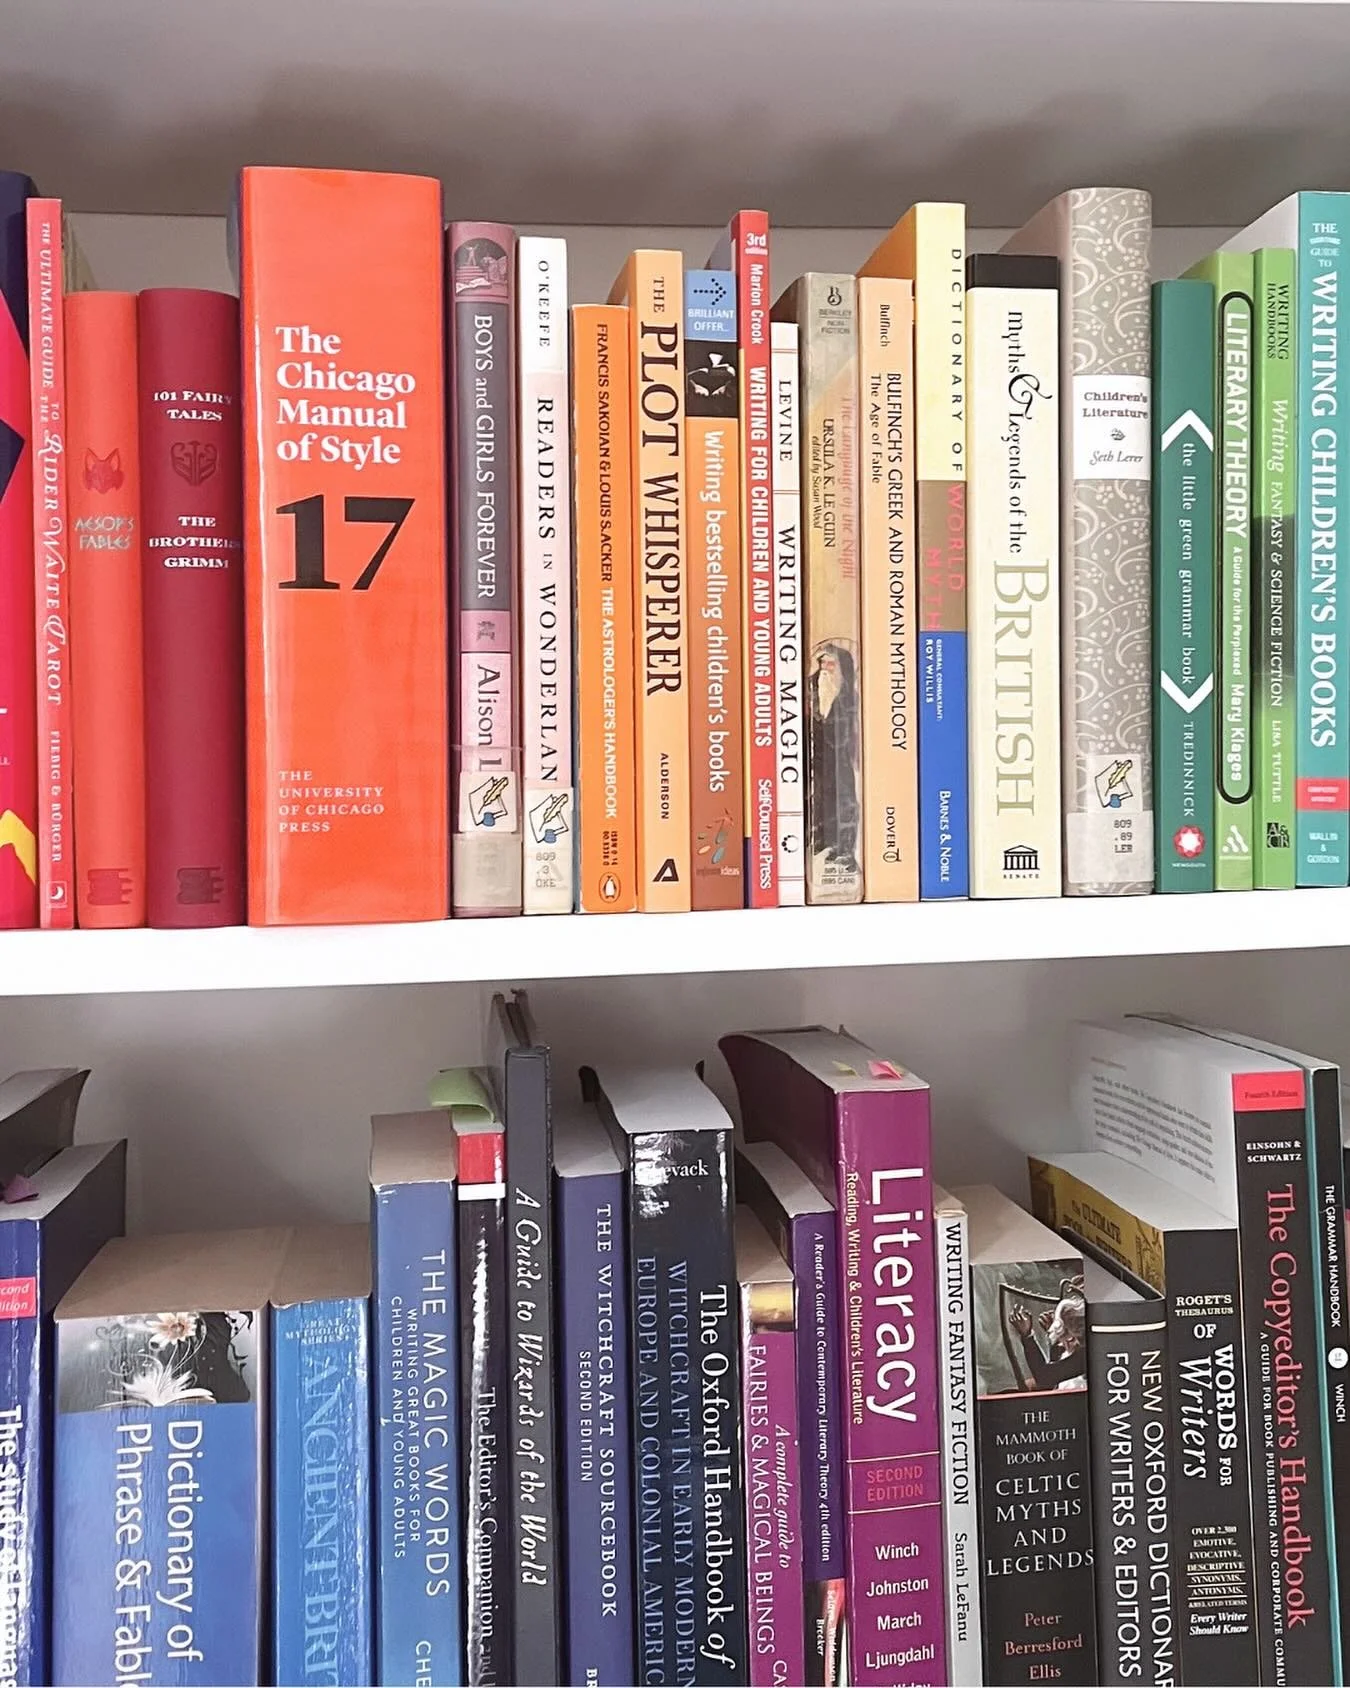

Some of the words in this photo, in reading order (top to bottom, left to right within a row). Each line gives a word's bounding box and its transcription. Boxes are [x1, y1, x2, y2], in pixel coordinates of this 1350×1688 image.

[747, 233, 766, 246] 3rd
[1312, 223, 1338, 233] THE
[1310, 248, 1340, 256] GUIDE
[537, 260, 550, 347] O'KEEFE
[653, 276, 665, 313] THE
[750, 264, 764, 307] Marion
[688, 308, 734, 319] BRILLIANT
[750, 309, 764, 345] Crook
[880, 304, 890, 347] Bulfinch
[951, 248, 963, 421] DICTIONARY
[1267, 283, 1276, 359] HANDBOOKS
[1277, 284, 1289, 360] WRITING
[276, 326, 341, 354] The
[474, 315, 493, 371] BOYS
[1312, 271, 1338, 417] WRITING
[154, 392, 178, 403] 101
[183, 391, 231, 404] FAIRY
[276, 362, 416, 400] Chicago
[474, 377, 492, 409] and
[641, 322, 679, 457] PLOT
[750, 366, 767, 440] WRITING
[1084, 392, 1148, 402] Children's
[166, 408, 223, 421] TALES
[276, 398, 407, 429] Manual
[779, 380, 792, 462] LEVINE
[887, 373, 903, 463] BULFINCH'S
[1082, 408, 1148, 418] Literature
[276, 432, 318, 461] of
[320, 436, 400, 471] Style
[474, 415, 495, 483] GIRLS
[700, 430, 725, 503] Writing
[751, 446, 767, 481] FOR
[951, 442, 963, 471] OF
[1089, 451, 1113, 465] Seth
[1117, 451, 1143, 463] Lerer
[1183, 443, 1195, 466] the
[887, 468, 904, 520] GREEK
[1182, 475, 1195, 510] little
[79, 535, 131, 550] FABLES
[178, 516, 216, 527] THE
[276, 494, 416, 590] 17
[751, 487, 769, 573] CHILDREN
[947, 484, 965, 591] WORLD
[1179, 519, 1192, 560] green
[1311, 428, 1337, 623] CHILDREN'S
[164, 557, 229, 568] GRIMM
[477, 492, 496, 599] FOREVER
[701, 509, 728, 620] bestselling
[889, 526, 904, 564] AND
[643, 472, 682, 696] WHISPERER
[752, 578, 770, 614] AND
[778, 525, 798, 665] WRITING
[889, 571, 904, 636] ROMAN
[926, 549, 942, 630] MYTH
[1179, 568, 1192, 638] grammar
[753, 617, 771, 677] YOUNG
[1182, 647, 1195, 684] book
[707, 626, 729, 724] children's
[890, 642, 907, 751] MYTHOLOGY
[994, 558, 1050, 816] BRITISH
[1310, 633, 1337, 748] BOOKS
[477, 664, 500, 747] Alison
[754, 682, 772, 747] ADULTS
[780, 680, 798, 783] MAGIC
[278, 771, 313, 781] THE
[708, 731, 731, 793] books
[1183, 722, 1194, 817] TREDINNICK
[279, 787, 384, 798] UNIVERSITY
[279, 805, 301, 816] OF
[305, 803, 385, 816] CHICAGO
[660, 753, 669, 820] ALDERSON
[279, 821, 331, 833] PRESS
[886, 806, 896, 848] DOVER
[1114, 819, 1132, 829] 809
[1114, 832, 1133, 841] .89
[1307, 854, 1340, 864] GORDON
[1247, 1153, 1302, 1163] SCHWARTZ
[515, 1188, 541, 1208] A
[1266, 1183, 1296, 1242] The
[597, 1204, 612, 1252] THE
[516, 1218, 542, 1289] Guide
[946, 1222, 963, 1314] WRITING
[422, 1250, 446, 1316] THE
[866, 1168, 924, 1422] Literacy
[1176, 1295, 1232, 1306] ROGET'S
[517, 1301, 536, 1321] to
[700, 1285, 728, 1345] The
[1175, 1307, 1234, 1316] THESAURUS
[1194, 1324, 1216, 1338] OF
[391, 1296, 403, 1380] CHILDREN
[408, 1309, 418, 1379] WRITING
[597, 1264, 615, 1437] WITCHCRAFT
[1263, 1252, 1303, 1449] Copyeditor's
[423, 1333, 448, 1448] MAGIC
[514, 1333, 544, 1427] Wizards
[579, 1351, 592, 1411] SECOND
[750, 1346, 769, 1427] FAIRIES
[949, 1322, 966, 1413] FANTASY
[1107, 1353, 1130, 1404] FOR
[392, 1389, 405, 1424] AND
[408, 1386, 419, 1438] GREAT
[700, 1352, 730, 1460] Oxford
[1022, 1412, 1050, 1424] THE
[1179, 1356, 1212, 1478] Writers
[1214, 1344, 1237, 1449] WORDS
[1335, 1384, 1346, 1422] WINCH
[393, 1428, 405, 1489] YOUNG
[516, 1438, 545, 1464] of
[580, 1422, 593, 1482] EDITION
[751, 1436, 769, 1451] &
[996, 1429, 1076, 1446] MAMMOTH
[1006, 1452, 1045, 1464] BOOK
[1049, 1450, 1068, 1462] OF
[409, 1445, 420, 1502] BOOKS
[866, 1465, 922, 1484] SECOND
[952, 1421, 968, 1505] FICTION
[995, 1472, 1081, 1496] CELTIC
[1109, 1412, 1135, 1527] WRITERS
[1219, 1457, 1232, 1486] FOR
[520, 1471, 546, 1504] the
[867, 1483, 923, 1501] EDITION
[996, 1498, 1082, 1522] MYTHS
[156, 1421, 203, 1613] Dictionary
[394, 1498, 405, 1558] ADULTS
[409, 1509, 421, 1542] FOR
[425, 1463, 450, 1596] WORDS
[599, 1449, 618, 1617] SOURCEBOOK
[752, 1458, 775, 1564] MAGICAL
[520, 1514, 547, 1586] World
[703, 1465, 735, 1625] Handbook
[875, 1543, 919, 1561] Winch
[954, 1533, 968, 1577] Sarah
[1014, 1527, 1067, 1547] AND
[1113, 1535, 1137, 1557] &
[1280, 1456, 1315, 1629] Handbook
[987, 1549, 1094, 1576] LEGENDS
[1187, 1562, 1245, 1571] DESCRIPTIVE
[866, 1577, 928, 1597] Johnston
[755, 1572, 775, 1654] BEINGS
[877, 1612, 921, 1631] March
[956, 1583, 969, 1641] LeFanu
[1024, 1613, 1063, 1626] Peter
[1115, 1565, 1141, 1677] EDITORS
[1190, 1613, 1215, 1624] Every
[1219, 1612, 1247, 1621] Writer
[167, 1624, 203, 1662] of
[700, 1633, 736, 1670] of
[865, 1644, 934, 1669] Ljungdahl
[1005, 1634, 1084, 1655] Berresford
[1029, 1665, 1061, 1680] Ellis
